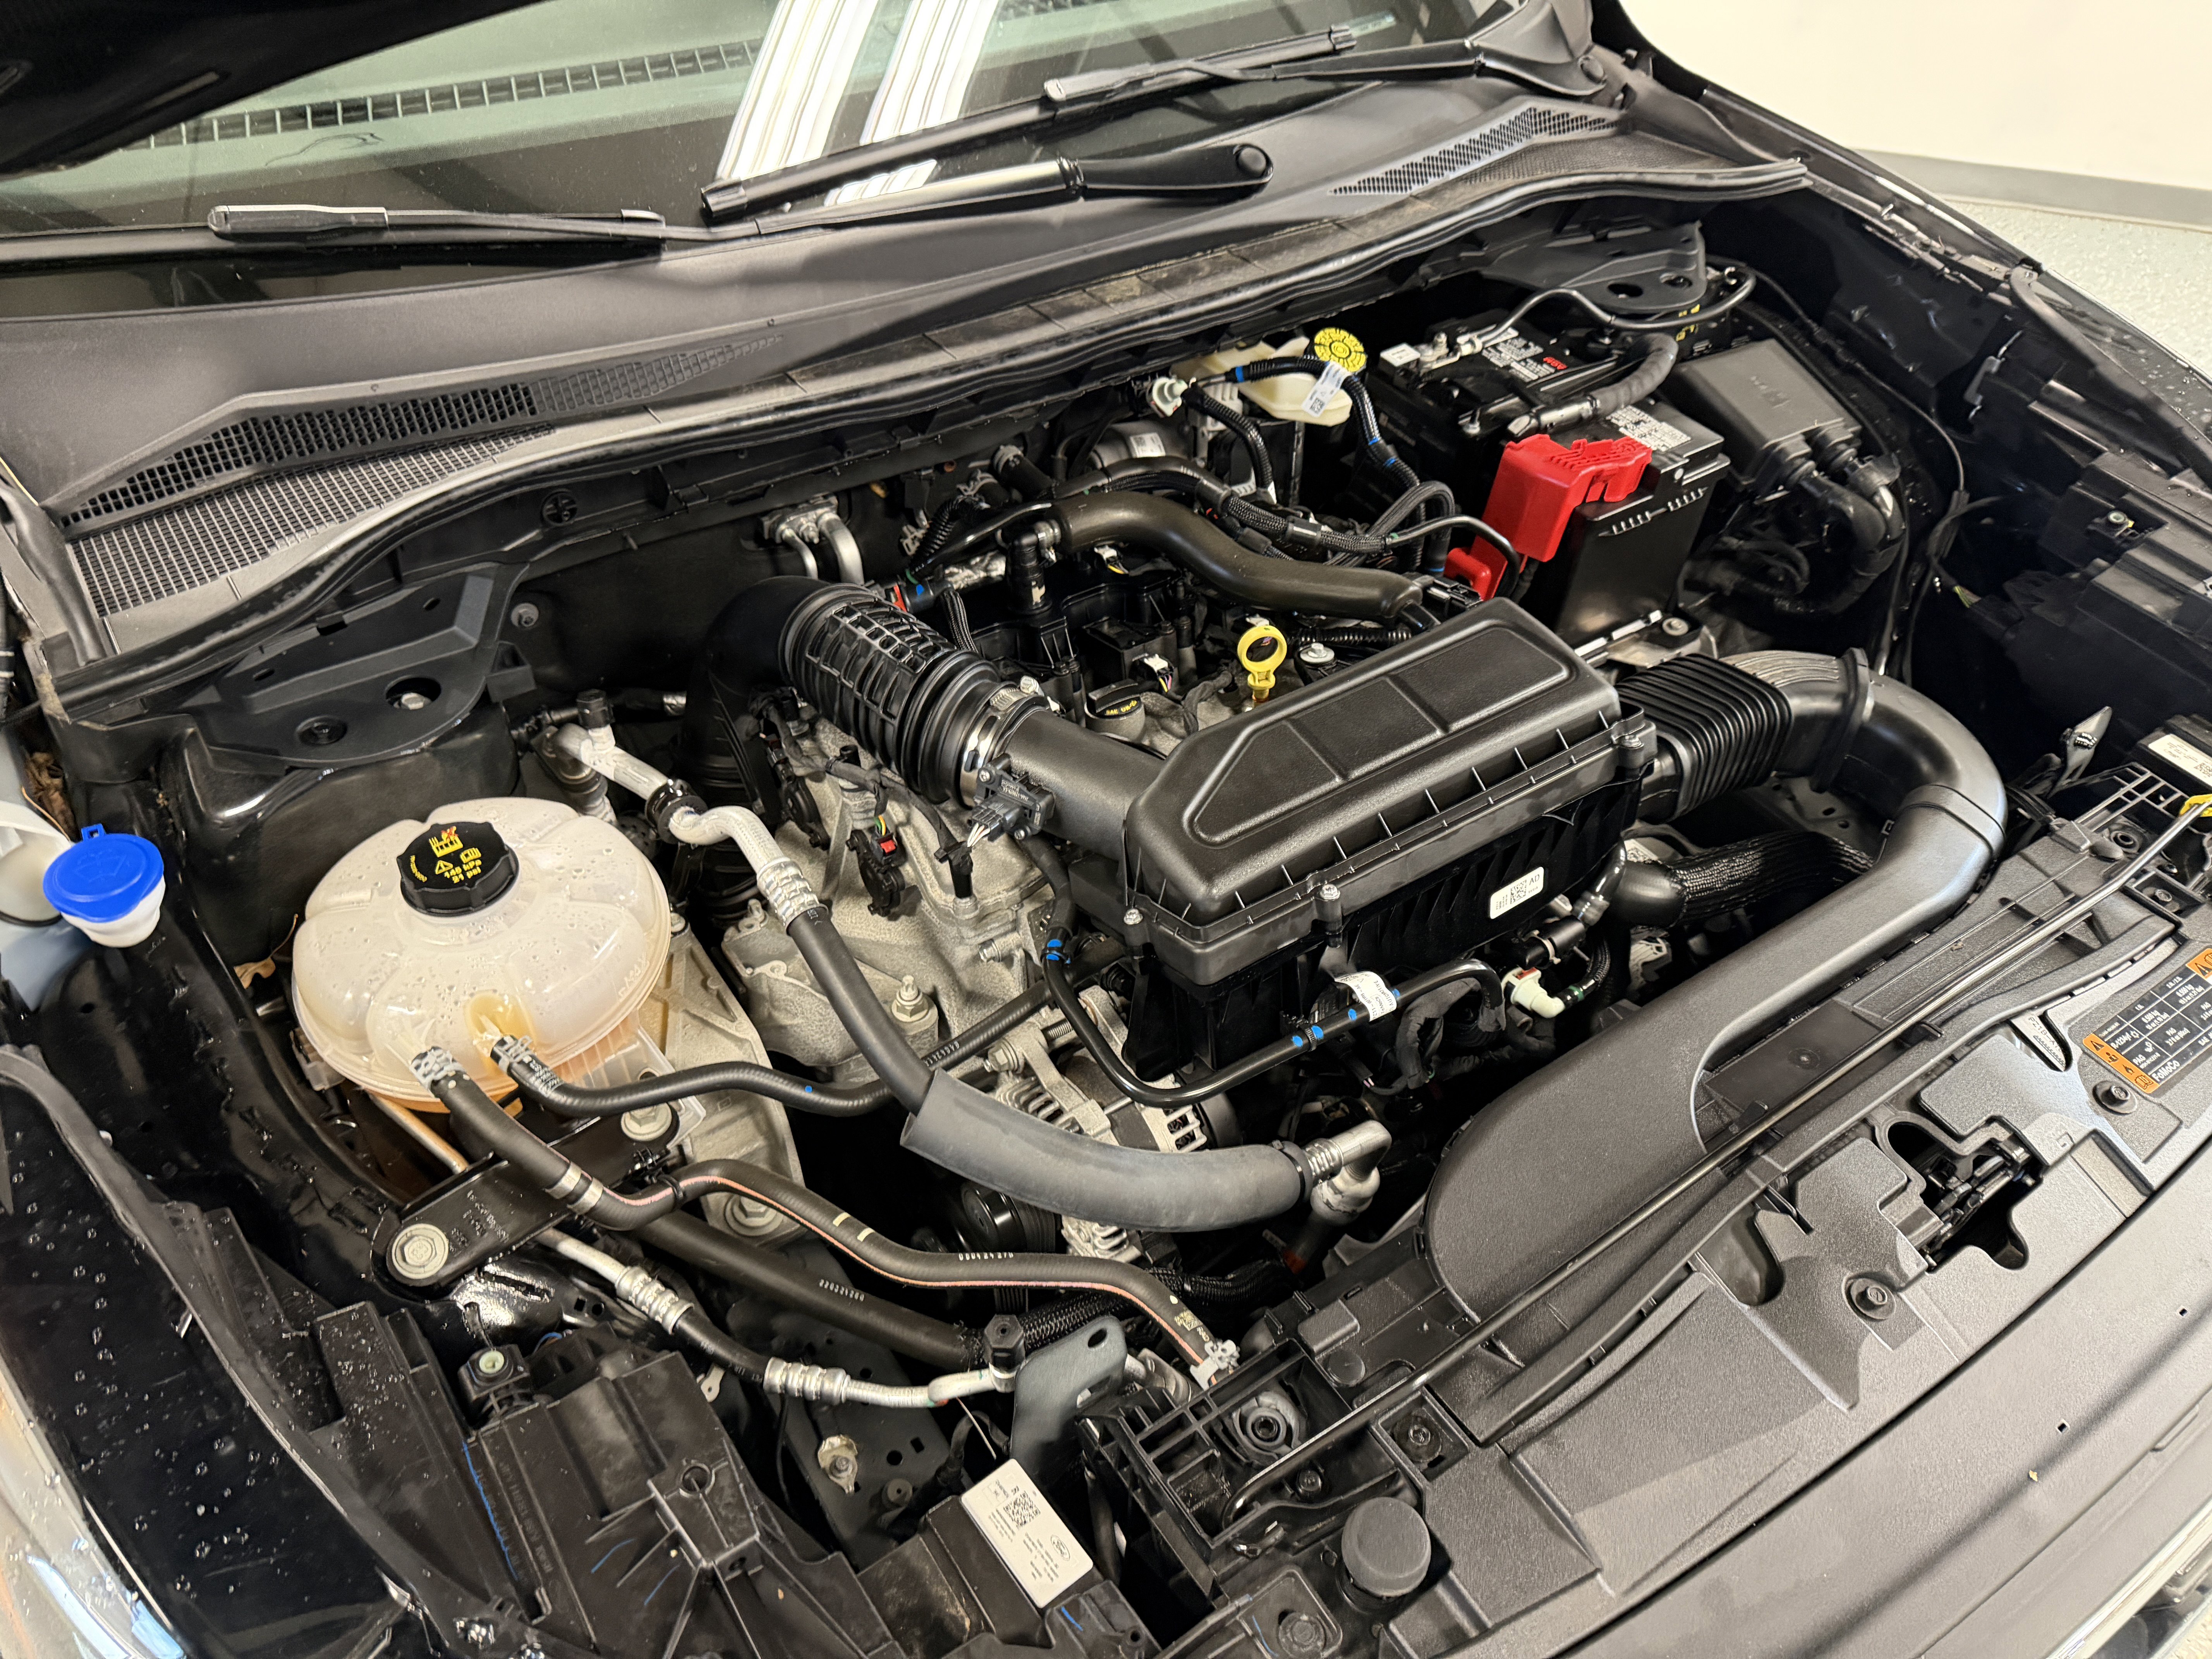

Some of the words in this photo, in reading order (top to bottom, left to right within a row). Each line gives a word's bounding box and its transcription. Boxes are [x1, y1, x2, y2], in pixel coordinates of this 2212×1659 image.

[444, 866, 462, 878] 145
[452, 876, 464, 884] 21
[466, 867, 481, 879] psi
[1529, 874, 1540, 886] AD
[2166, 1027, 2177, 1036] PAG
[2198, 1036, 2210, 1046] SAE
[2133, 1054, 2146, 1065] PAG
[2152, 1060, 2180, 1082] FoMoCo
